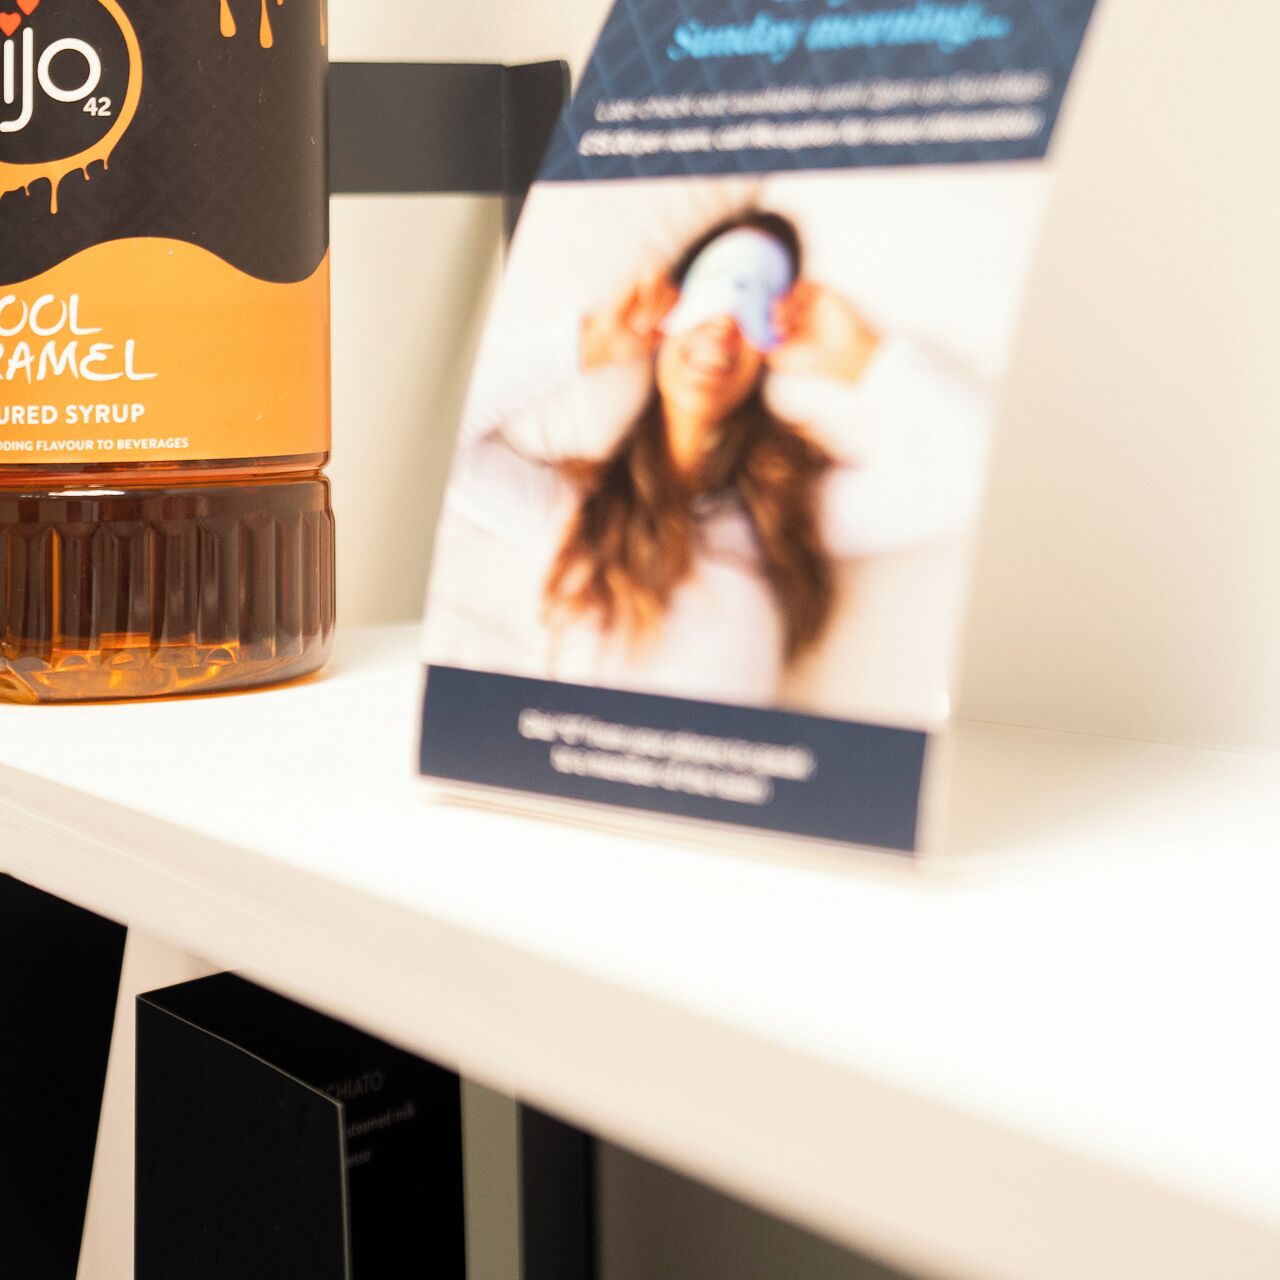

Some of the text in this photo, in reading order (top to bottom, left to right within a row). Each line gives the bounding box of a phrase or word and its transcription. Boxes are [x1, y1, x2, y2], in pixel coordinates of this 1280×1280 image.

[668, 12, 801, 64] Sunday
[82, 96, 112, 117] 42
[64, 403, 145, 424] SYRUP
[35, 439, 94, 451] FLAVOUR
[96, 439, 114, 450] TO
[117, 437, 189, 450] BEVERAGES
